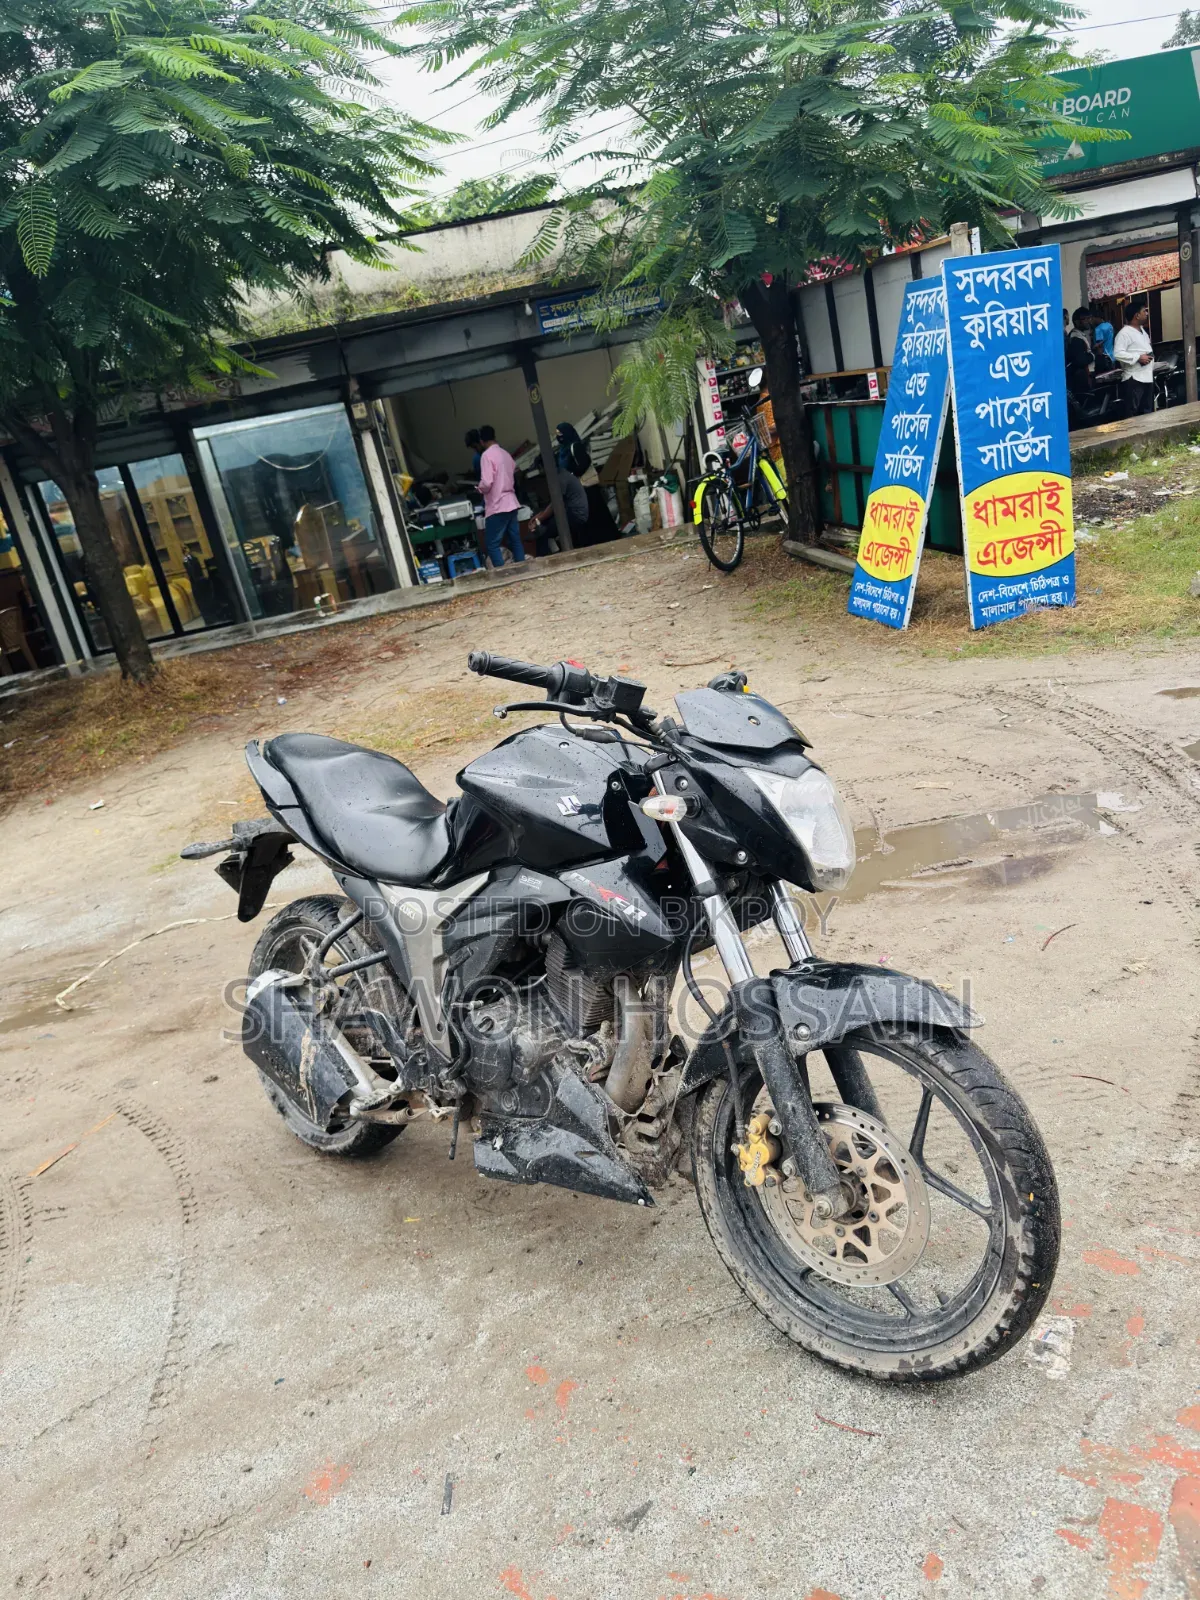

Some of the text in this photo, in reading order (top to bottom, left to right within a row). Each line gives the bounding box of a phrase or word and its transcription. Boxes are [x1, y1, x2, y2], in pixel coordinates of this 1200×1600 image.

[1096, 107, 1131, 123] CAN
[952, 257, 1053, 304] সুন্দরবন
[906, 286, 945, 325] সুন্দরব
[902, 322, 946, 368] কুরিয়ার
[960, 301, 1051, 350] কুরিয়ার
[905, 372, 930, 399] এন্ড
[989, 351, 1033, 382] এন্ড
[891, 404, 932, 440] পার্সেল
[975, 383, 1052, 428] পার্সেল
[884, 445, 924, 481] সার্ভিস
[977, 426, 1052, 471] সার্ভিস
[869, 500, 920, 537] ধামরাই
[973, 479, 1065, 528] ধামরাই
[862, 537, 912, 575] এজেন্সী
[976, 520, 1066, 568] এজেন্সী
